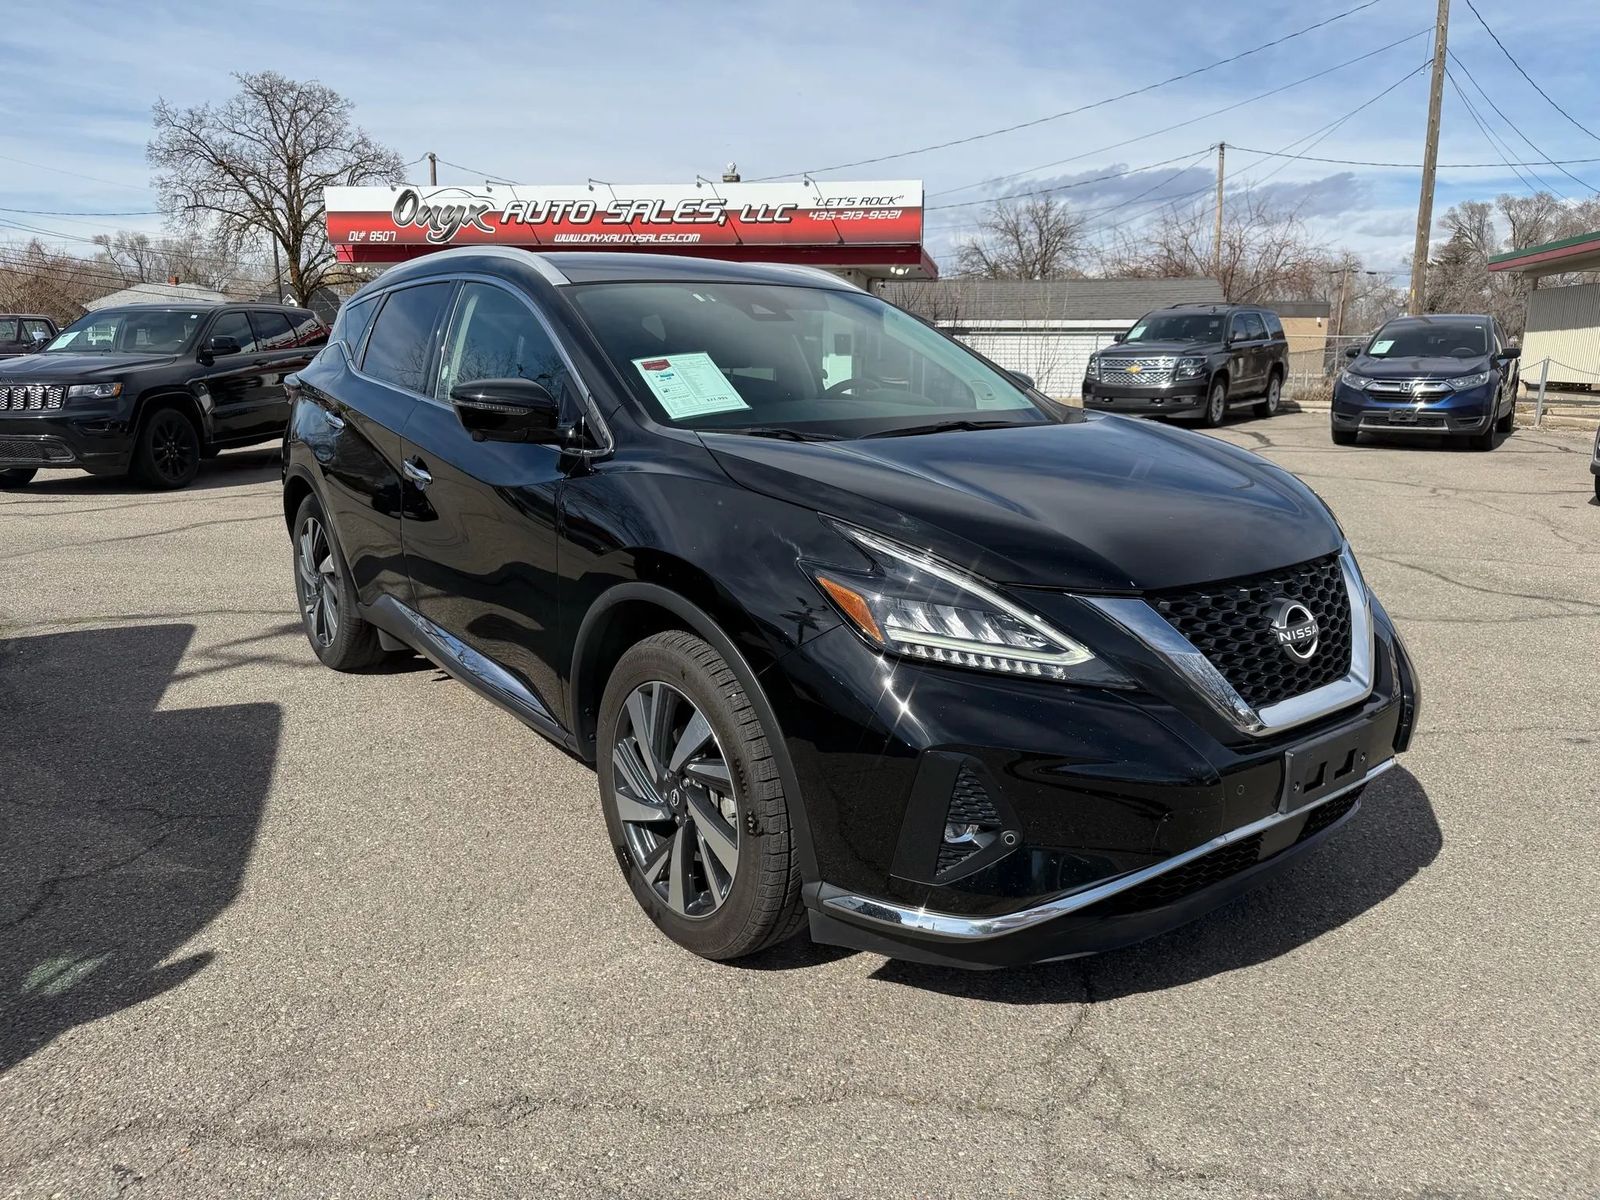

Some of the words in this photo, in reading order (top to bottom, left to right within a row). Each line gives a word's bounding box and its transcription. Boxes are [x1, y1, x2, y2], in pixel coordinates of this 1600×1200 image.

[392, 188, 495, 244] Onyx
[501, 200, 597, 225] AUTO
[602, 199, 727, 226] SALES,
[739, 203, 799, 224] LLC
[808, 209, 902, 221] 435-213-9221
[348, 230, 366, 241] DL#
[369, 230, 397, 242] 8507
[554, 233, 701, 243] WWW.ONYXAUTOSALES.COM
